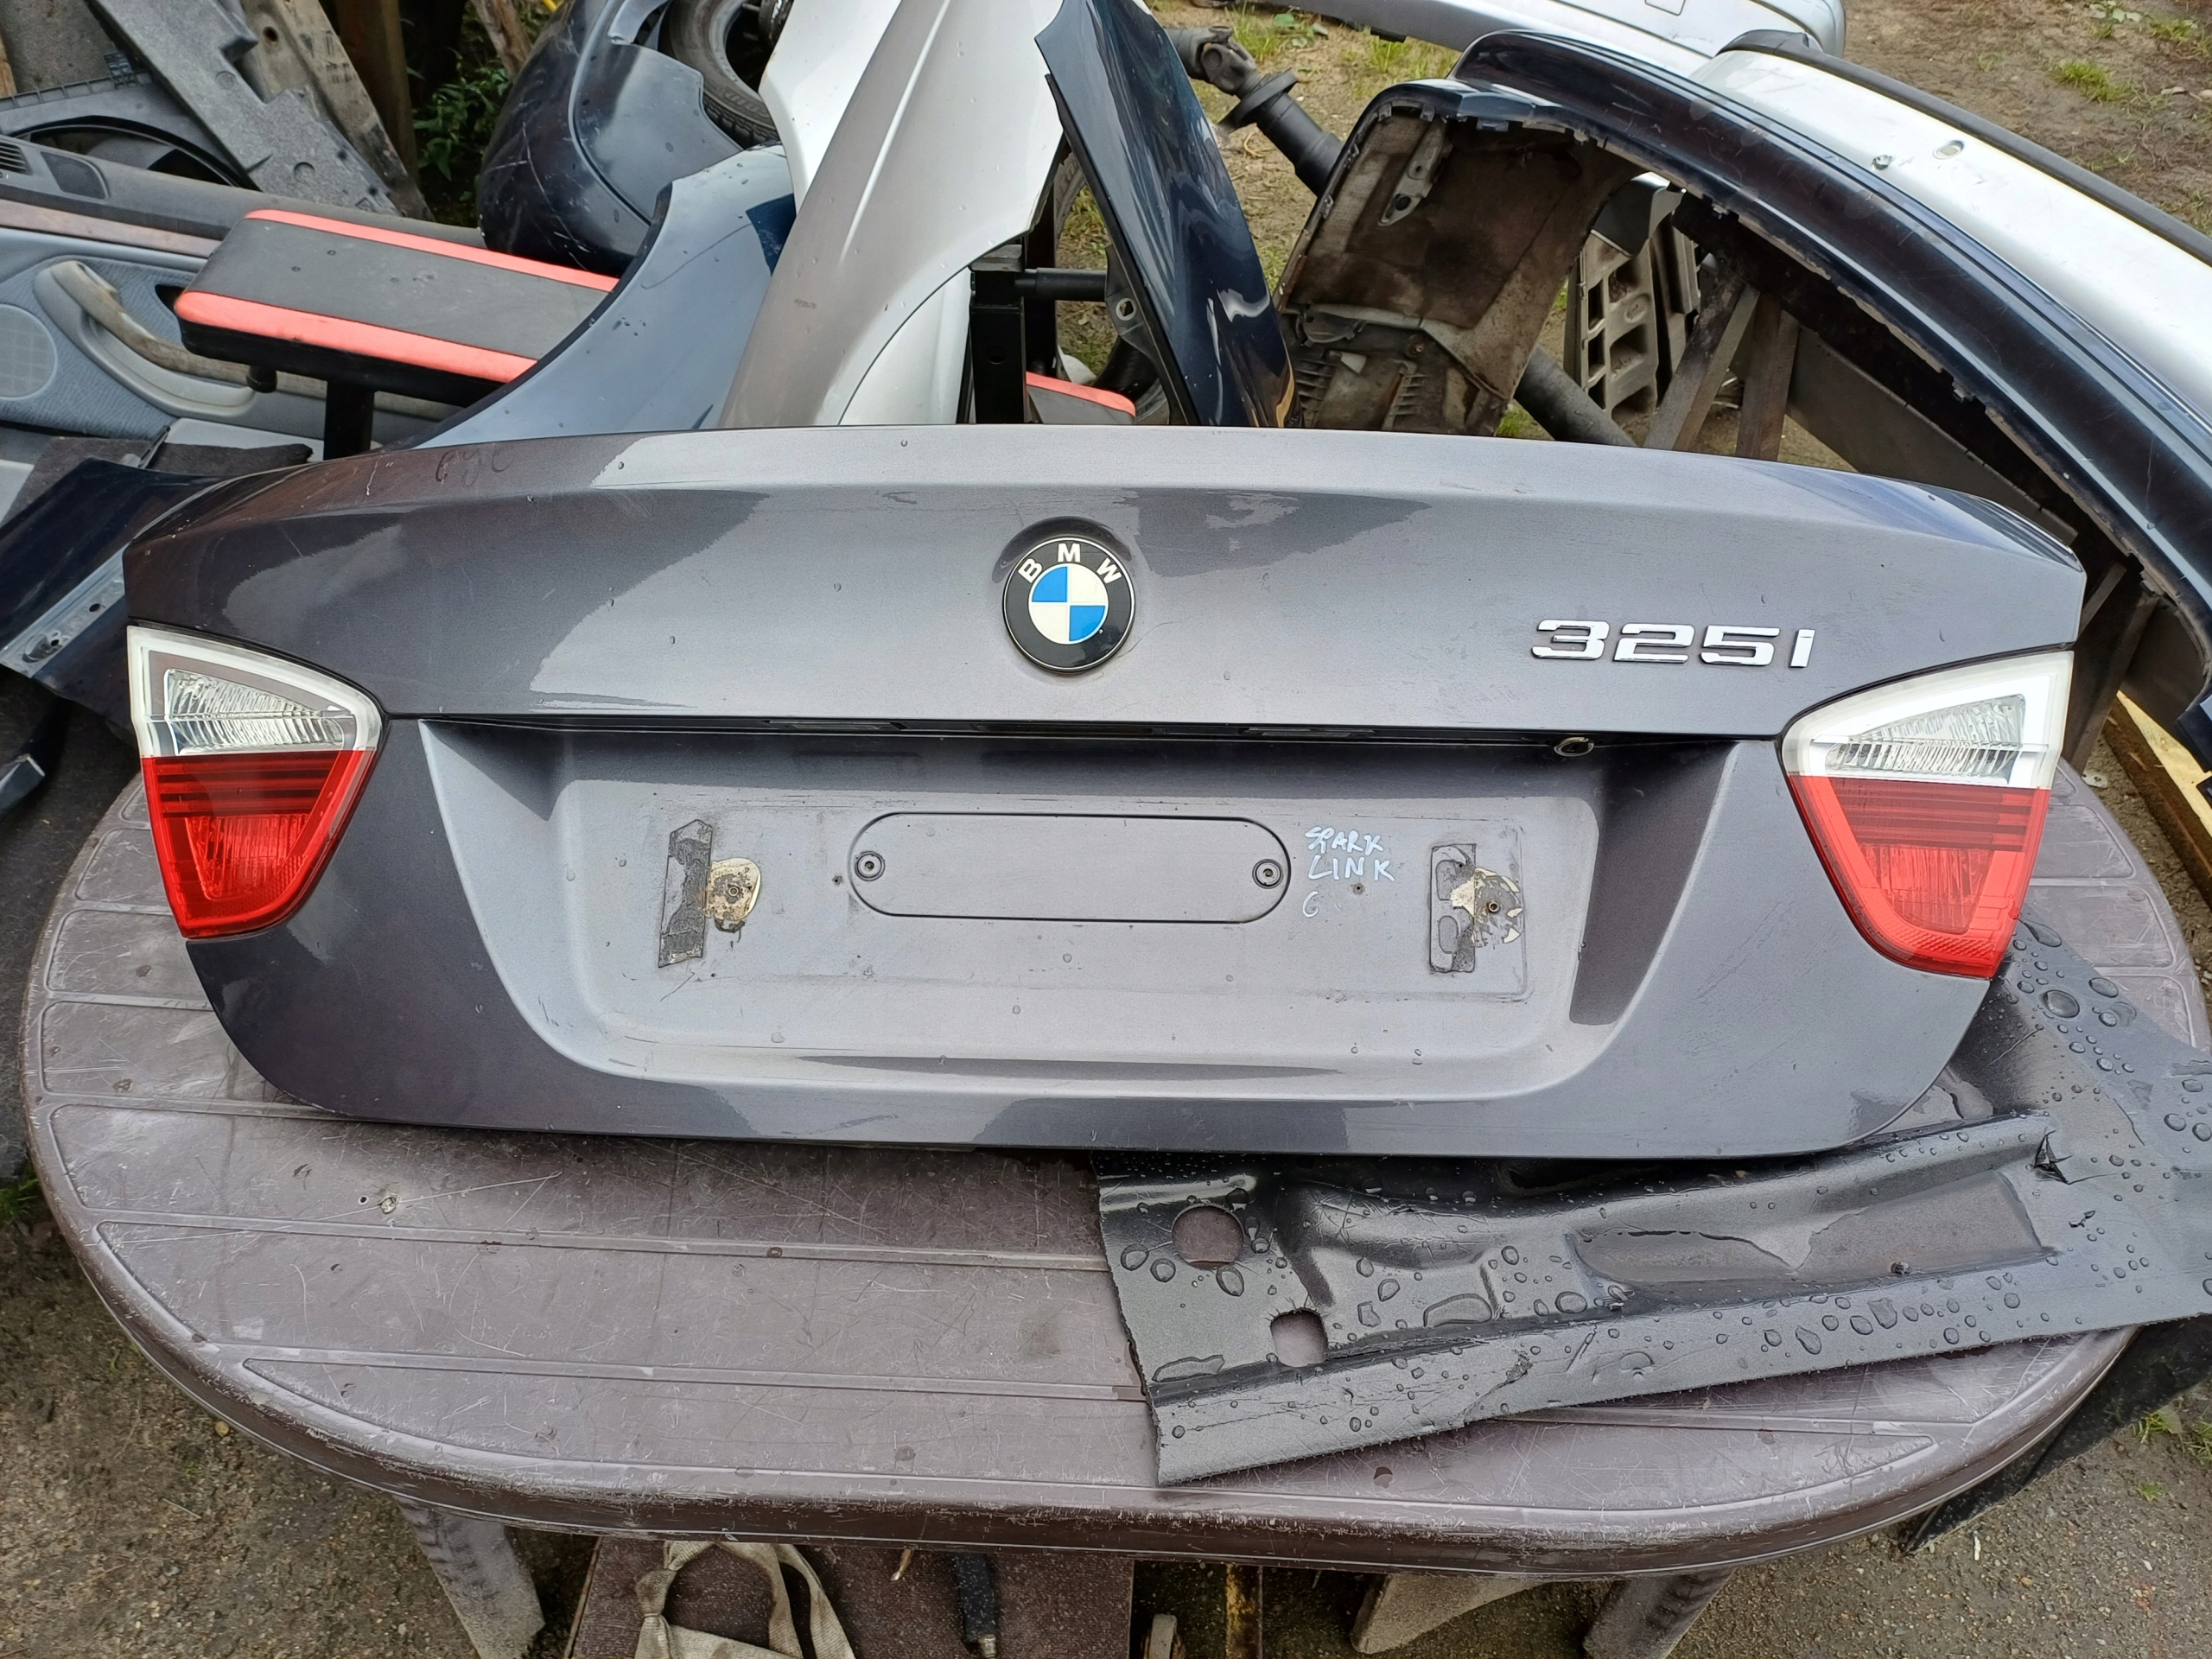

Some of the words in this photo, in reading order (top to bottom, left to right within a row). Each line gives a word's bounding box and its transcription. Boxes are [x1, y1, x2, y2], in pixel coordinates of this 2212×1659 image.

[1018, 543, 1122, 583] BMW
[1305, 826, 1383, 855] SPARK
[1308, 855, 1395, 882] LINK
